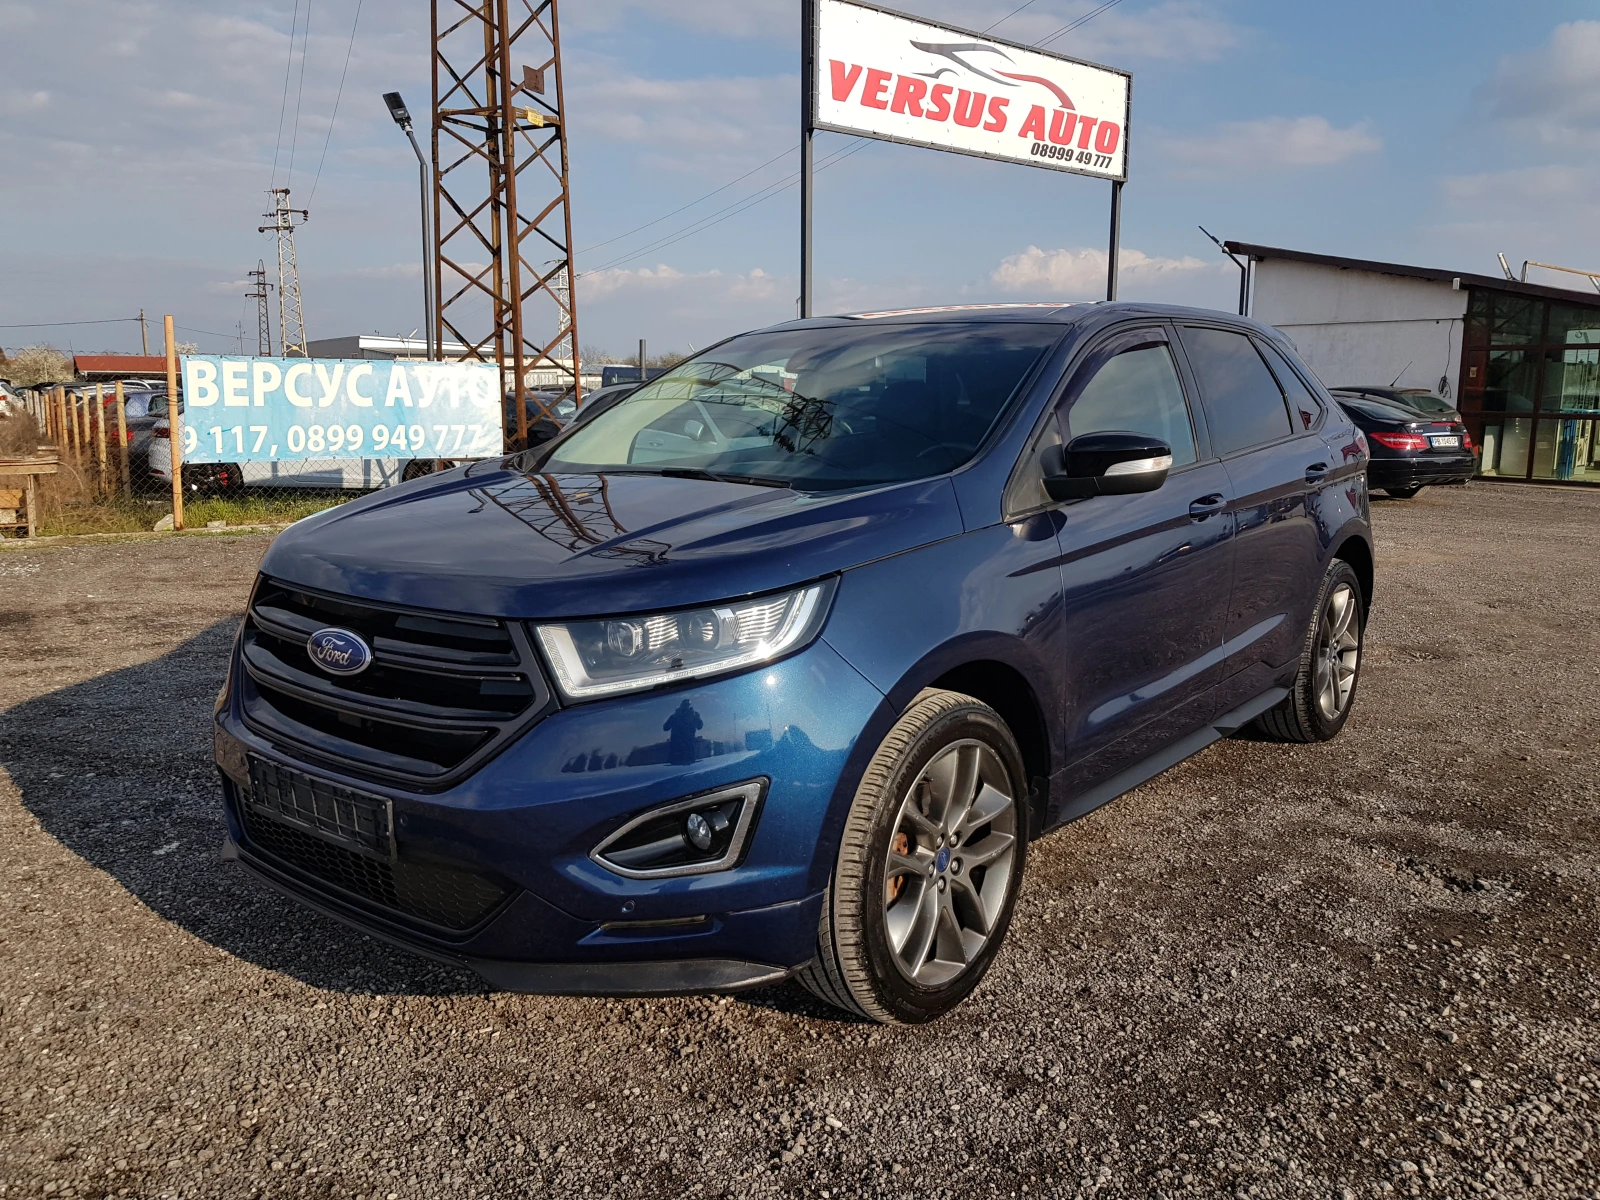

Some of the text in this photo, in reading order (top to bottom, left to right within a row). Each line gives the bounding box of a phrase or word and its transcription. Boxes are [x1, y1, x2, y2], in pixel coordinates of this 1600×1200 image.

[829, 59, 1121, 155] VERSUS AUTO
[1030, 142, 1113, 169] 08999 49 777
[186, 360, 496, 408] ВЕРСУС АУТО
[209, 425, 278, 457] 117,
[287, 424, 364, 453] 0899
[371, 424, 426, 451] 949
[432, 424, 483, 451] 777
[317, 636, 353, 665] Ford
